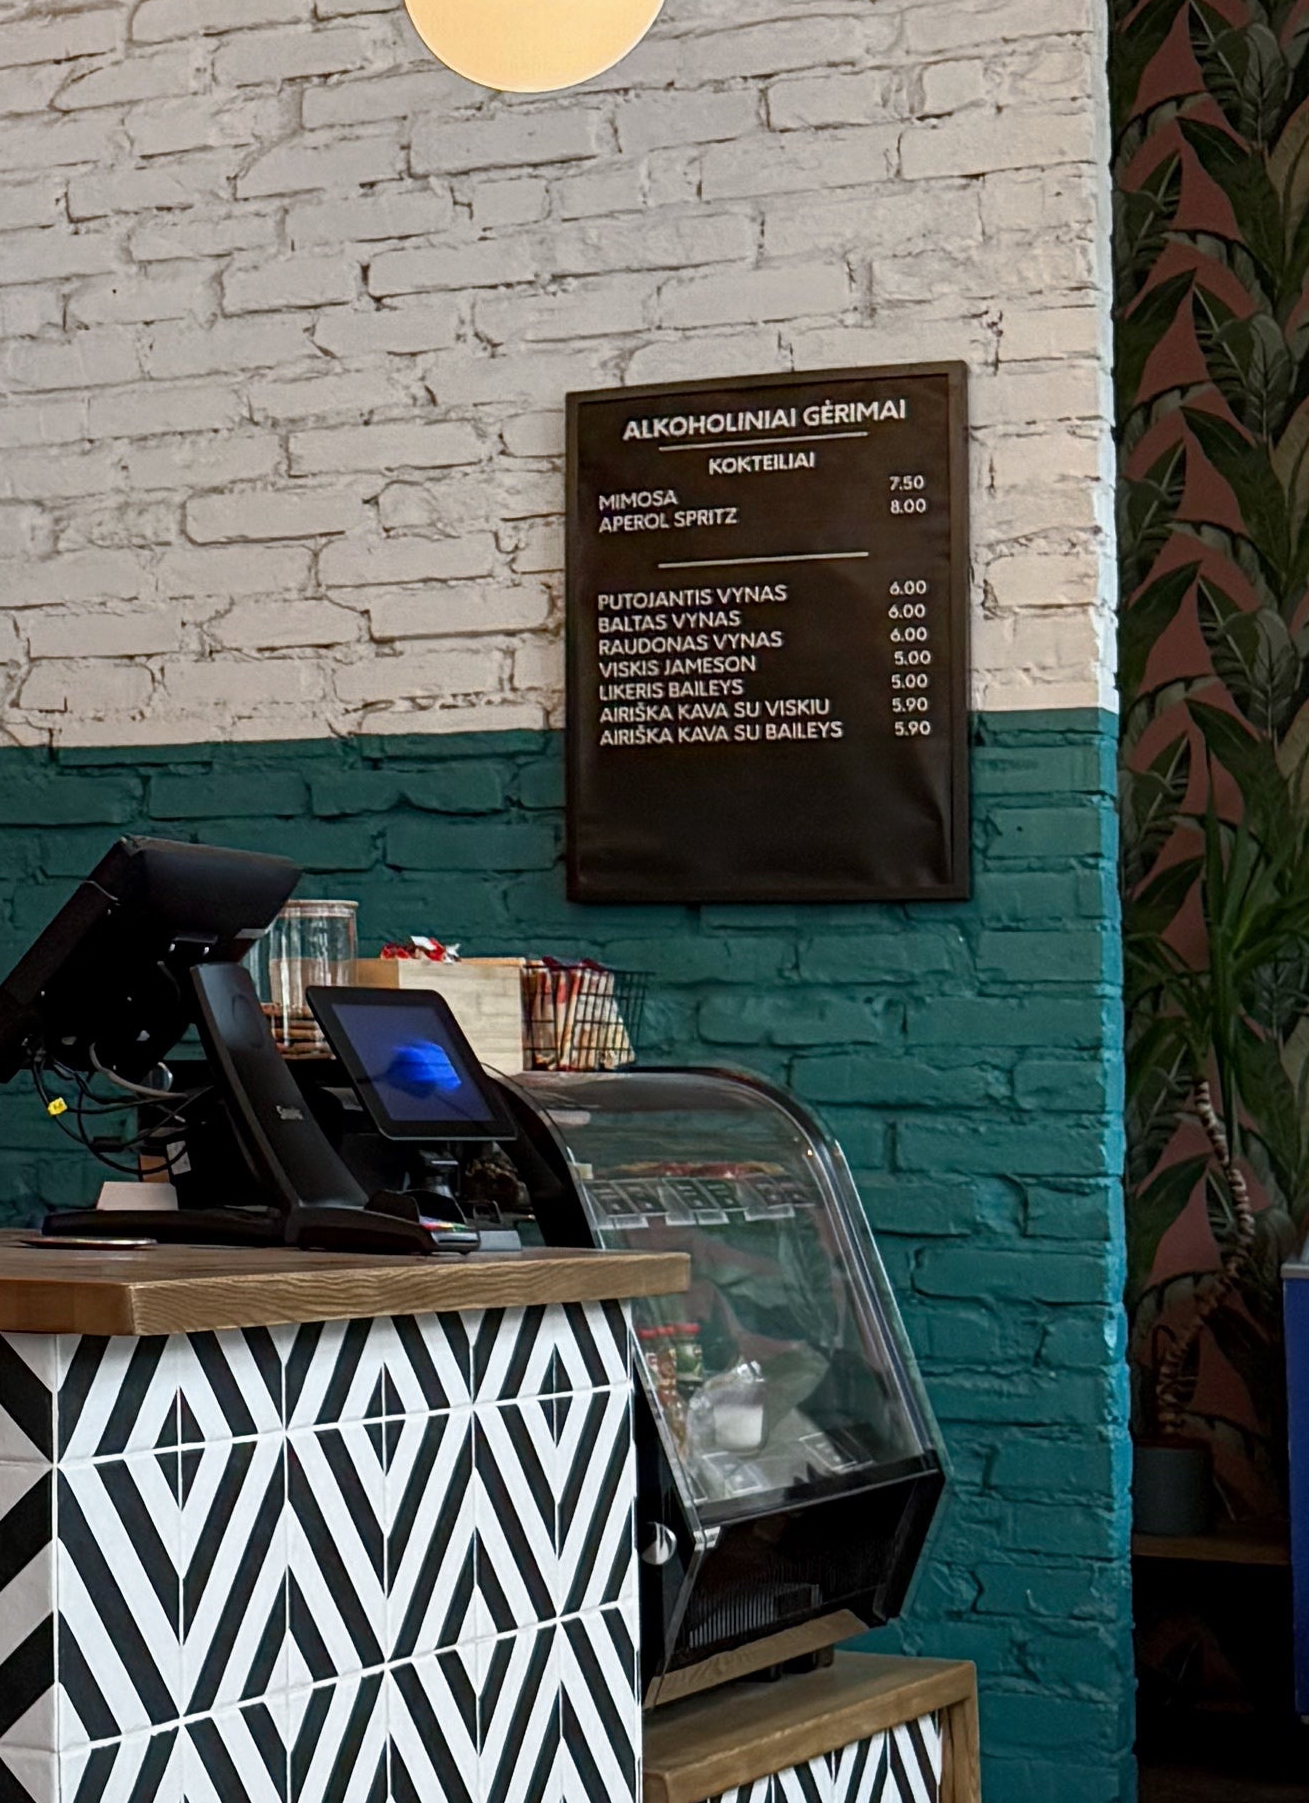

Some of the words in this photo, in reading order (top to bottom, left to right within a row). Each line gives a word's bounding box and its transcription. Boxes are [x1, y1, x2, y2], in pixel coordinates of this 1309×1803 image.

[623, 408, 796, 440] ALKOHOLINIAI
[803, 399, 905, 426] GĖRIMAI
[709, 452, 815, 475] KOKTEILIAI
[599, 490, 678, 511] MIMOSA
[890, 475, 924, 491] 7.50
[599, 513, 669, 533] APEROL
[674, 507, 737, 527] SPRITZ
[890, 498, 926, 514] 8.00
[598, 589, 712, 610] PUTOJANTIS
[716, 584, 787, 604] VYNAS
[890, 580, 927, 595] 6.00
[598, 614, 667, 633] BALTAS
[672, 610, 741, 629] VYNAS
[888, 604, 926, 619] 6.00
[599, 634, 708, 655] RAUDONAS
[713, 631, 782, 650] VYNAS
[890, 627, 927, 642] 6.00
[599, 660, 659, 678] VISKIS
[664, 655, 756, 675] JAMESON
[894, 650, 931, 665] 5.00
[599, 682, 664, 701] LIKERIS
[669, 679, 743, 698] BAILEYS
[891, 674, 928, 689] 5.00
[600, 702, 673, 723] AIRIŠKA
[678, 702, 729, 720] KAVA
[734, 701, 759, 718] SU
[765, 698, 829, 716] VISKIU
[892, 697, 928, 712] 5.90
[600, 725, 673, 745] AIRIŠKA
[678, 725, 729, 743] KAVA
[734, 724, 760, 741] SU
[766, 721, 843, 740] BAILEYS
[895, 721, 931, 736] 5.90
